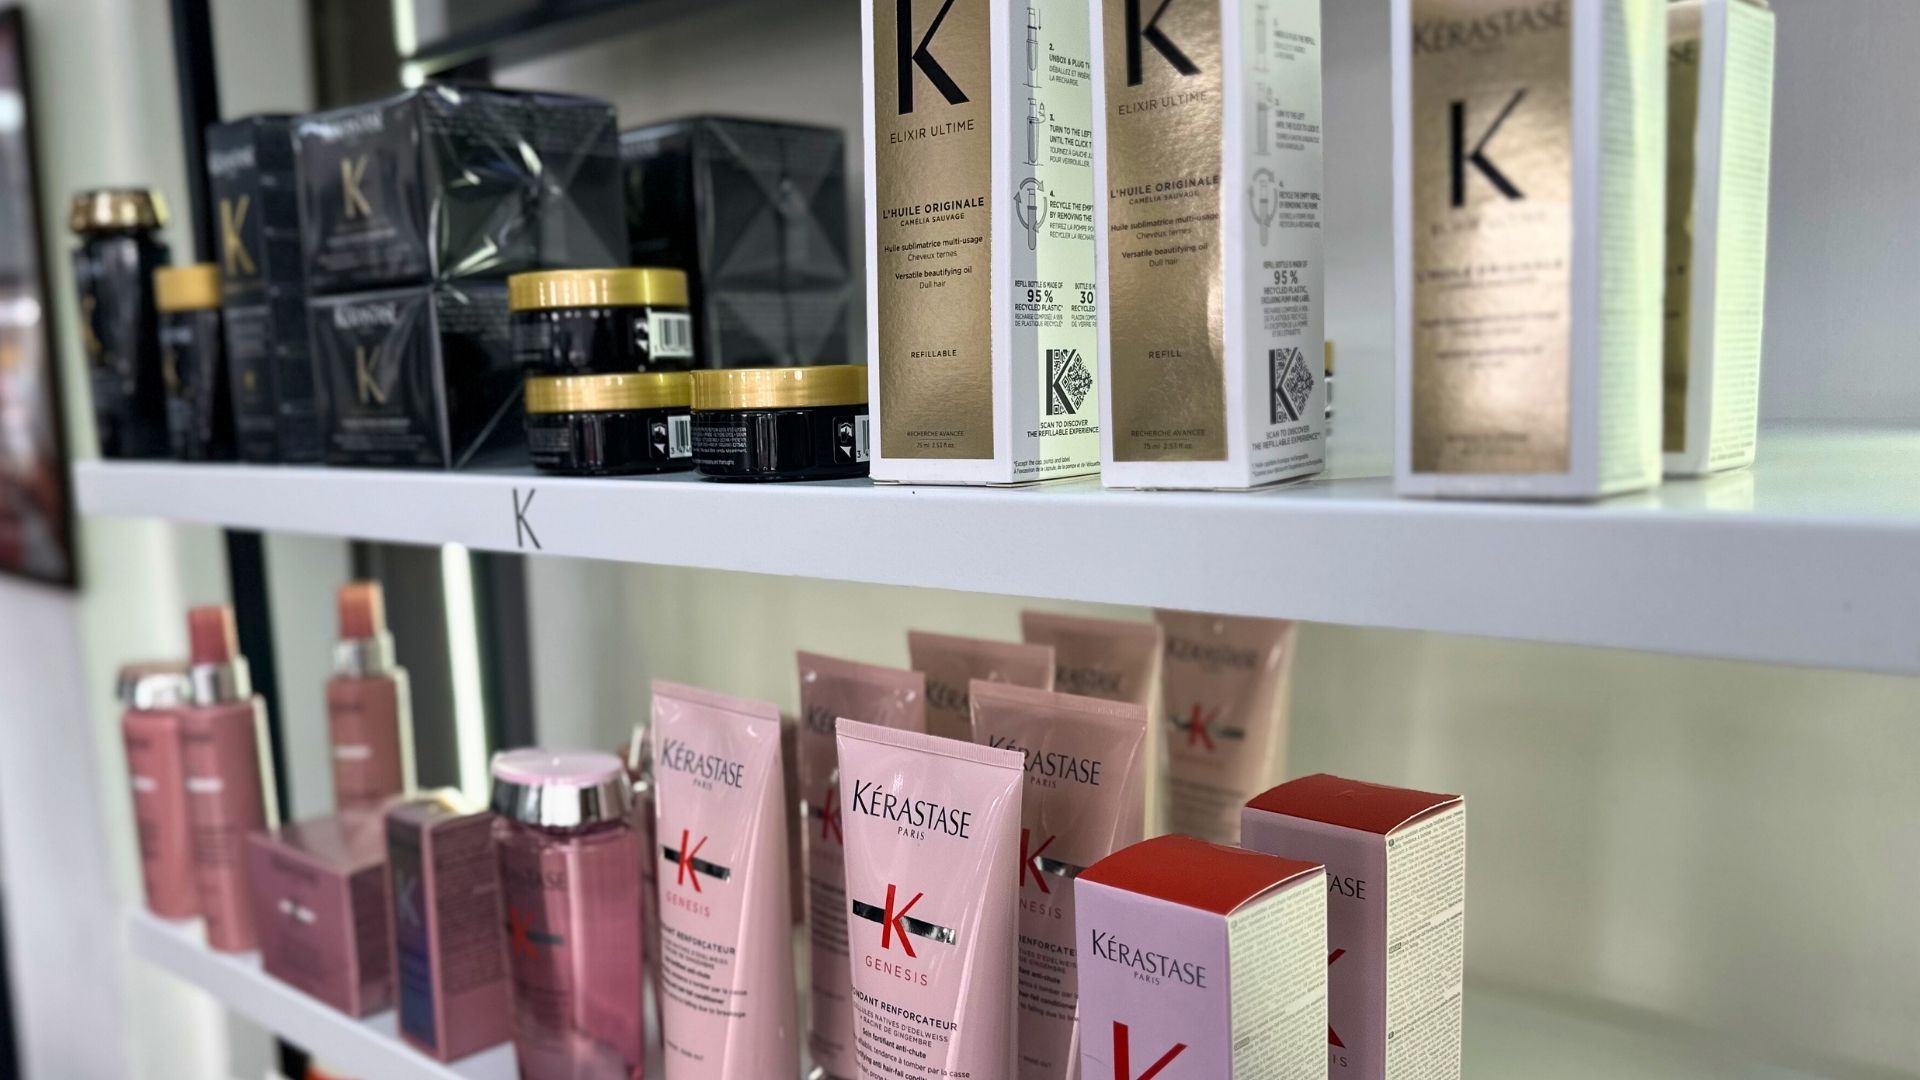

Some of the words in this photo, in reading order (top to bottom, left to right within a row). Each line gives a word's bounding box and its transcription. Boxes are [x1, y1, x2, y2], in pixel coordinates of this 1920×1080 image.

[1124, 0, 1202, 87] K
[897, 0, 970, 115] K
[1119, 99, 1157, 115] ELIXIR
[1161, 91, 1207, 107] ULTIME
[890, 129, 926, 144] ELIXIR
[930, 119, 975, 137] ULTIME
[1050, 124, 1063, 133] TURN
[1064, 126, 1070, 135] TO
[1071, 128, 1080, 136] THE
[1050, 135, 1064, 144] UNTIL
[1064, 138, 1074, 146] THE
[1451, 87, 1527, 208] K
[340, 153, 372, 218] K
[1110, 185, 1151, 198] L'HUILE
[1155, 175, 1219, 192] ORIGINALE
[883, 205, 921, 219] L'HUILE
[924, 197, 985, 213] ORIGINALE
[1072, 203, 1081, 211] THE
[1083, 214, 1092, 222] THE
[900, 217, 930, 226] CAMÉLIA
[932, 213, 965, 222] SAUVAGE
[1110, 223, 1128, 232] Huile
[1130, 218, 1173, 230] sublimatrice
[220, 195, 257, 277] K
[884, 244, 900, 253] Huile
[901, 240, 941, 251] sublimatrice
[943, 236, 983, 247] multi-usage
[907, 253, 935, 261] Cheveux
[936, 250, 958, 259] ternes
[1122, 250, 1153, 258] Versatile
[1154, 245, 1196, 256] beautifying
[1149, 259, 1163, 267] Dull
[895, 270, 923, 280] Versatile
[924, 267, 961, 277] beautifying
[963, 266, 972, 274] oil
[919, 281, 932, 289] Dull
[1080, 291, 1094, 304] 30
[910, 350, 957, 359] REFILLABLE
[1148, 350, 1182, 359] REFILL
[1038, 428, 1068, 437] REFILLABLE
[1069, 427, 1099, 435] EXPERIENCE
[1040, 421, 1055, 429] SCAN
[1063, 419, 1088, 427] DISCOVER
[513, 488, 541, 549] K
[661, 738, 744, 789] KÉRASTASE
[989, 735, 1101, 786] RASTASE
[1030, 776, 1057, 789] PARIS
[853, 779, 972, 839] KÉRASTASE
[897, 826, 925, 841] PARIS
[678, 829, 708, 893] K
[1019, 828, 1056, 894] K
[666, 890, 710, 918] GENESIS
[1020, 898, 1062, 919] NESIS
[882, 884, 924, 958] K
[1019, 934, 1075, 957] ENFORÇATE
[1092, 929, 1207, 988] KÉRASTASE
[865, 955, 928, 987] GENESIS
[1133, 971, 1160, 986] PARIS
[875, 1012, 900, 1029] NATIVES
[901, 1025, 949, 1043] D'EDELWEISS
[880, 1001, 958, 1031] RENFORÇATEUR
[863, 1018, 882, 1031] RACINE
[883, 1027, 891, 1035] DE
[893, 1030, 932, 1048] GINGEMBRE
[872, 1033, 895, 1048] fortifiant
[895, 1043, 926, 1059] anti-chute
[873, 1046, 897, 1062] tendance
[903, 1059, 926, 1072] tomber
[927, 1066, 940, 1075] par
[882, 1063, 904, 1077] hair-fall
